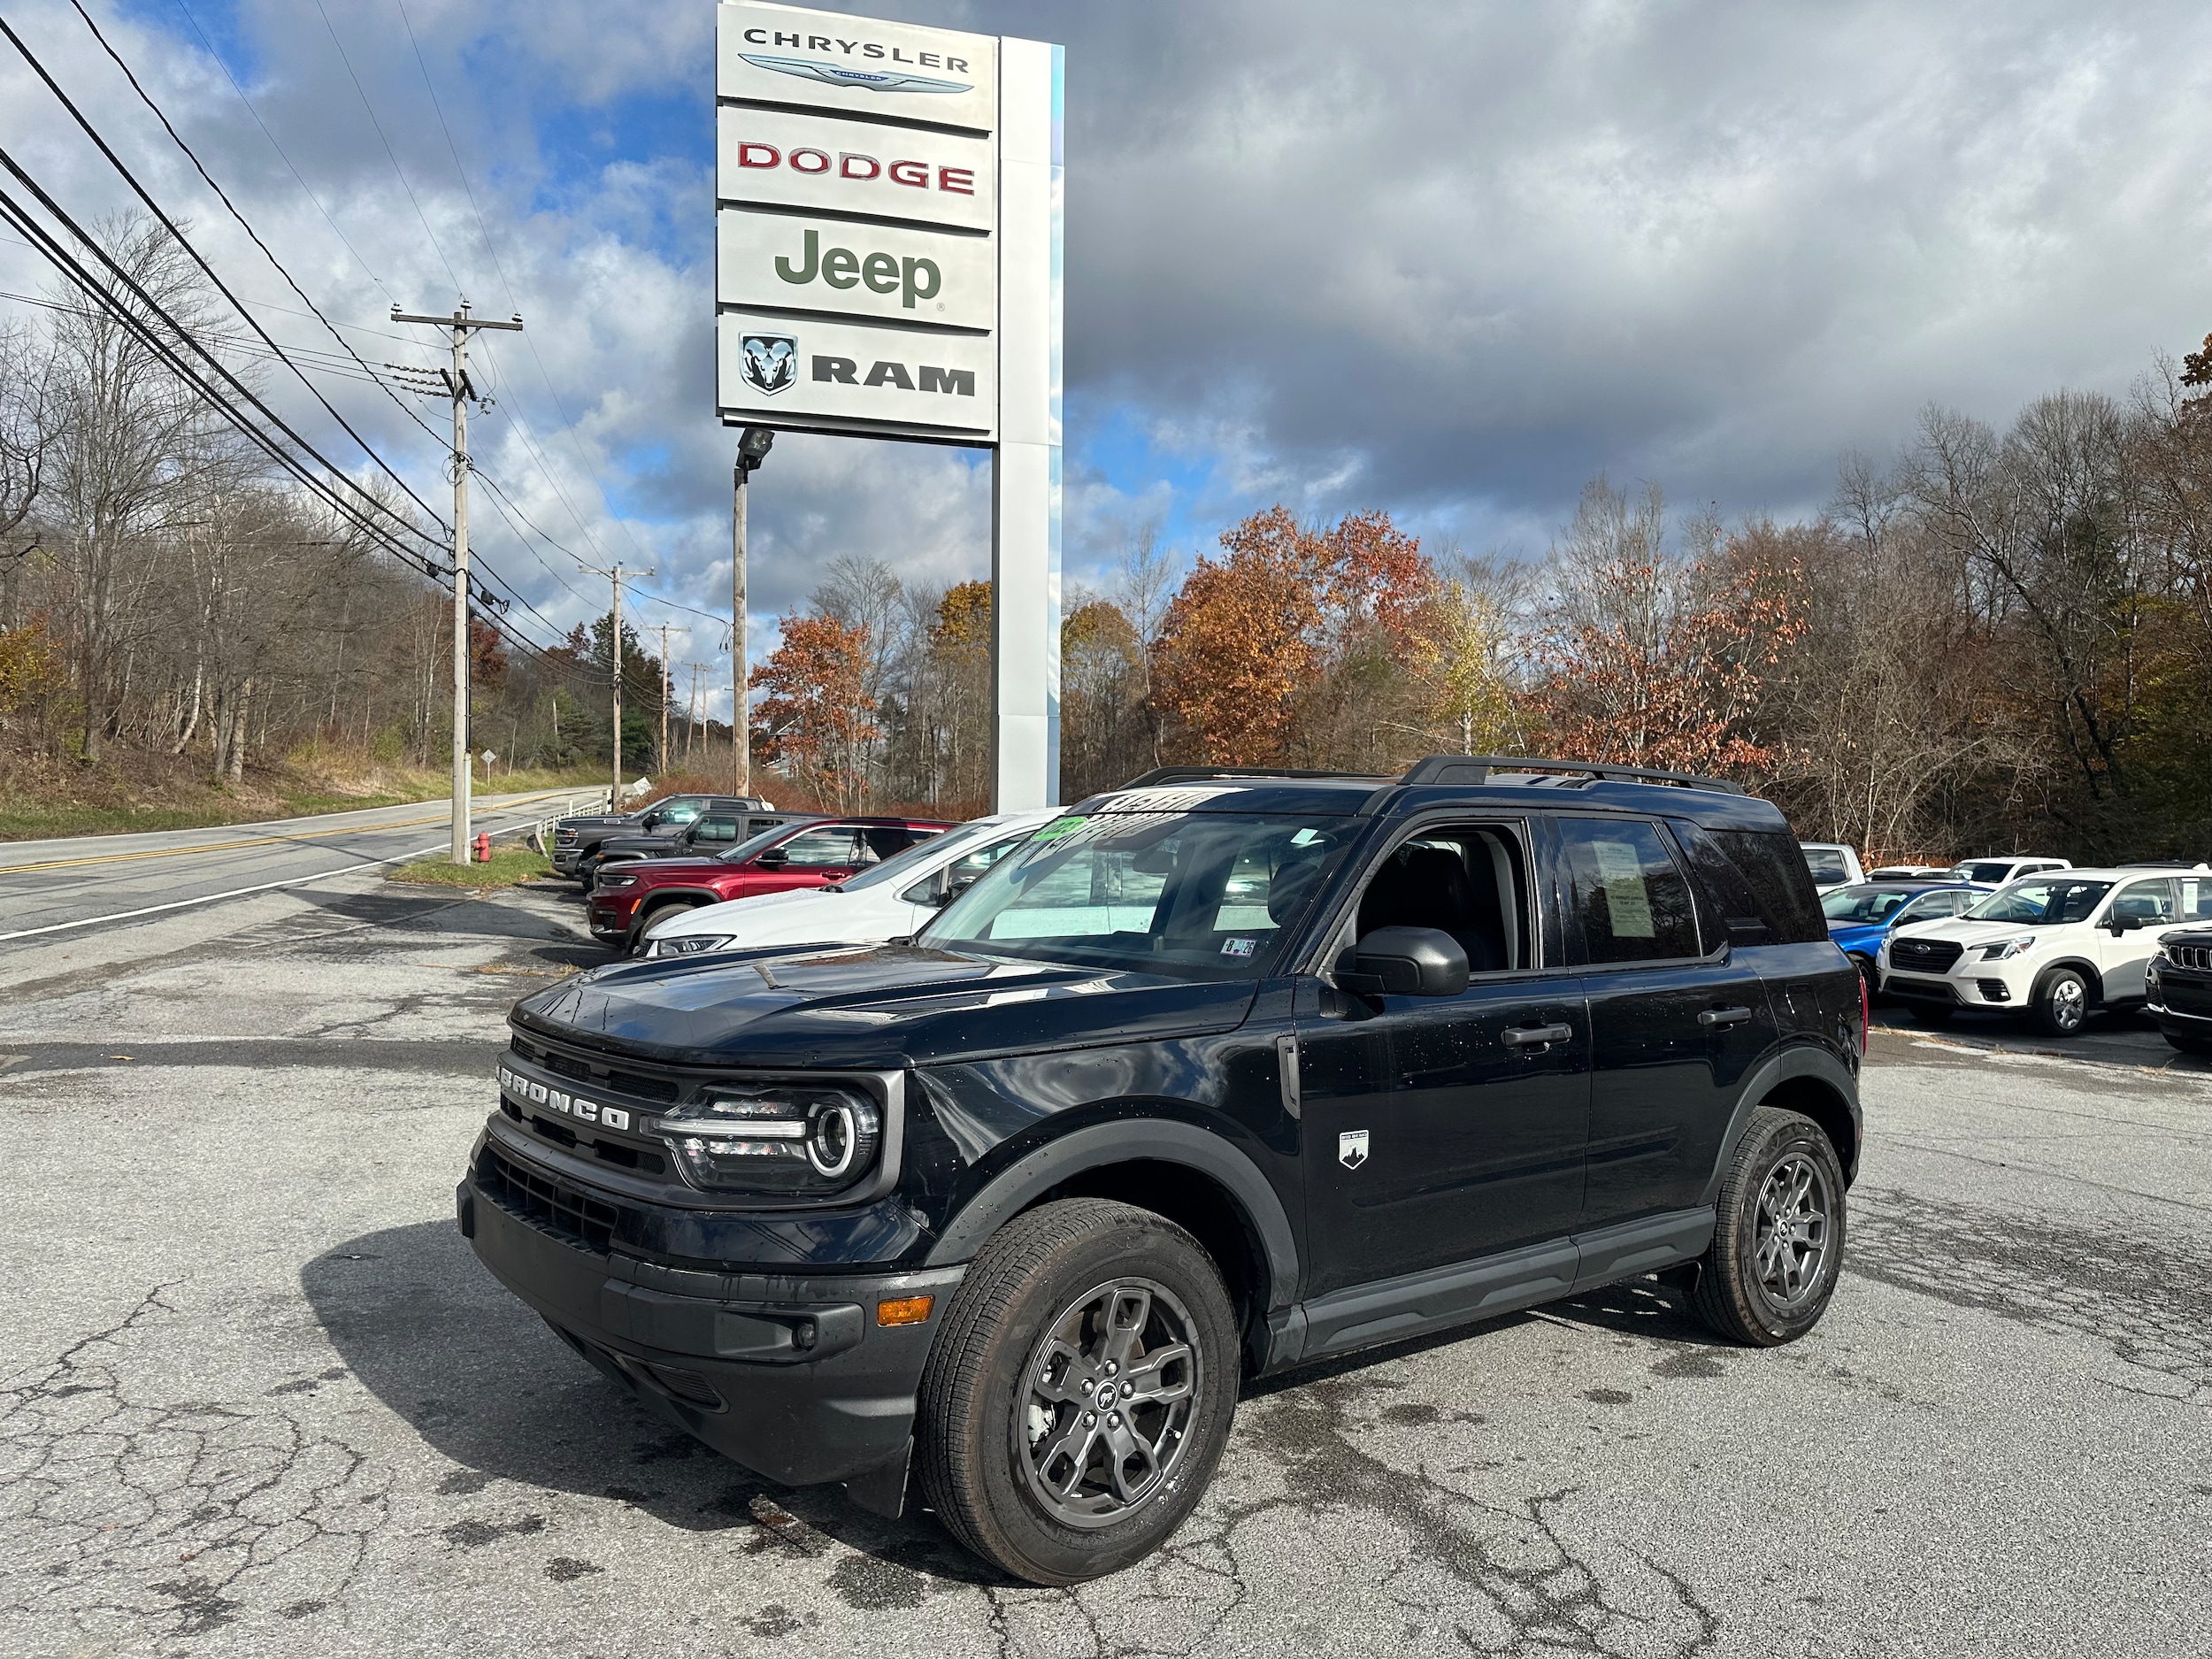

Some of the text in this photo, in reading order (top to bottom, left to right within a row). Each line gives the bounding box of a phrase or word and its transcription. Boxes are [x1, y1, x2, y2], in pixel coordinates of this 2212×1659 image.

[743, 28, 969, 73] CHRYSLER
[835, 71, 882, 81] CHRYSLER
[738, 141, 975, 196] DODGE
[775, 229, 941, 309] Jeep
[812, 355, 975, 396] RAM
[500, 1066, 630, 1131] BRONCO
